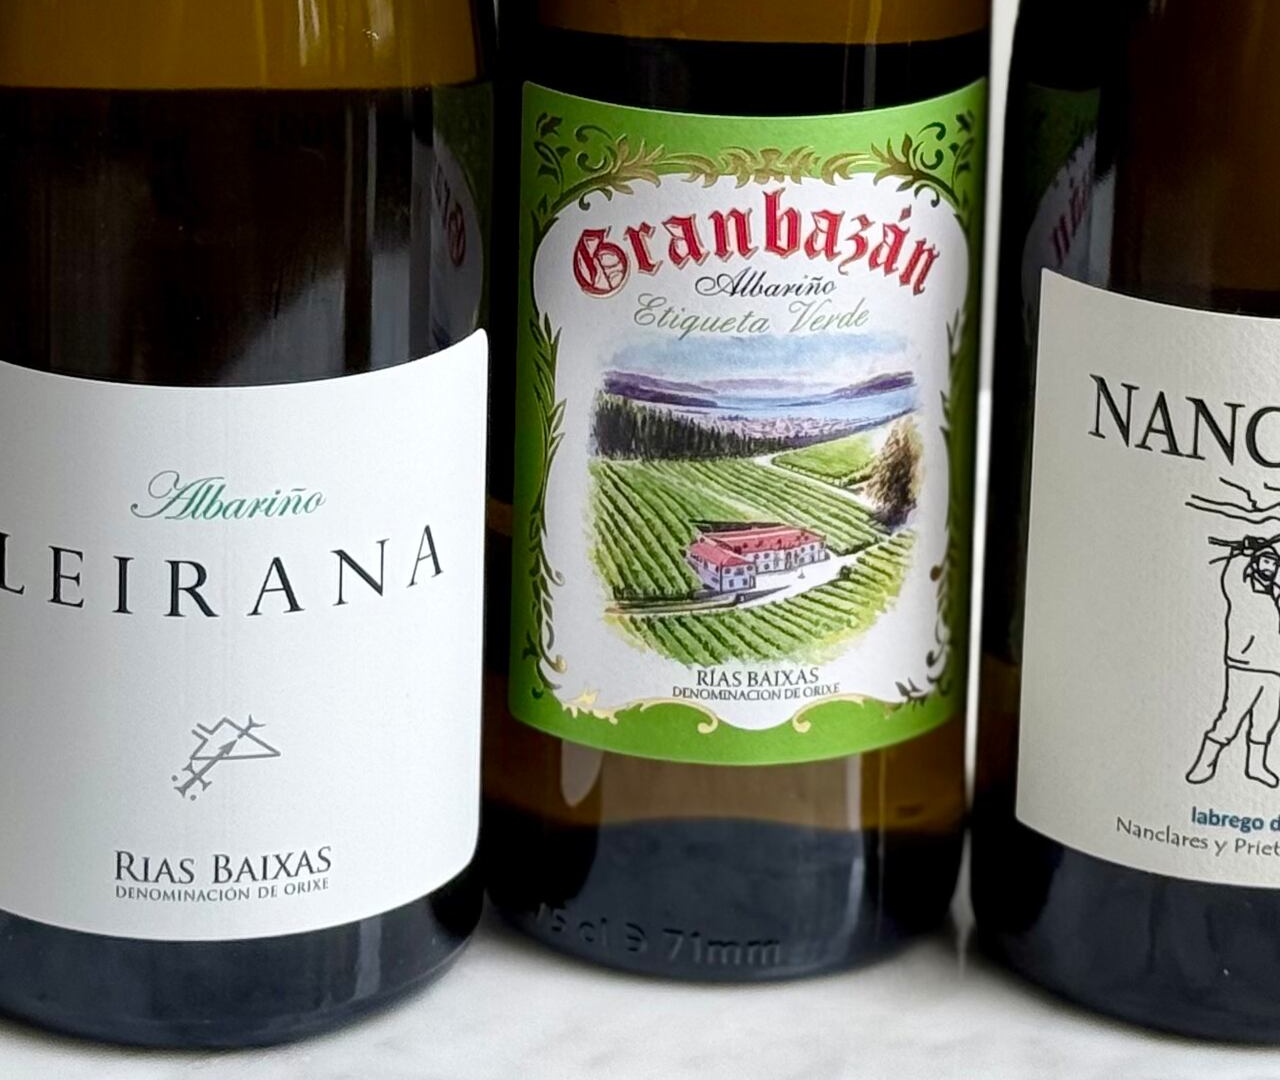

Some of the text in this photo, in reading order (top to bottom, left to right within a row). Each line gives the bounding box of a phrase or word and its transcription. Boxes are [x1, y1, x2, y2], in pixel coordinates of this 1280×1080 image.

[573, 187, 941, 299] Granbazán
[695, 267, 837, 299] Albariño
[634, 293, 870, 341] Etiqueta Verde
[130, 470, 326, 521] Albariño
[747, 667, 820, 688] BAIXAS
[784, 687, 801, 700] DE
[803, 682, 840, 697] ORIXE
[1116, 816, 1208, 849] Nanclares
[1214, 839, 1228, 857] y
[1191, 806, 1264, 833] labrego
[212, 846, 332, 885] BAIXAS
[257, 885, 278, 899] DE
[284, 877, 329, 896] ORIXE
